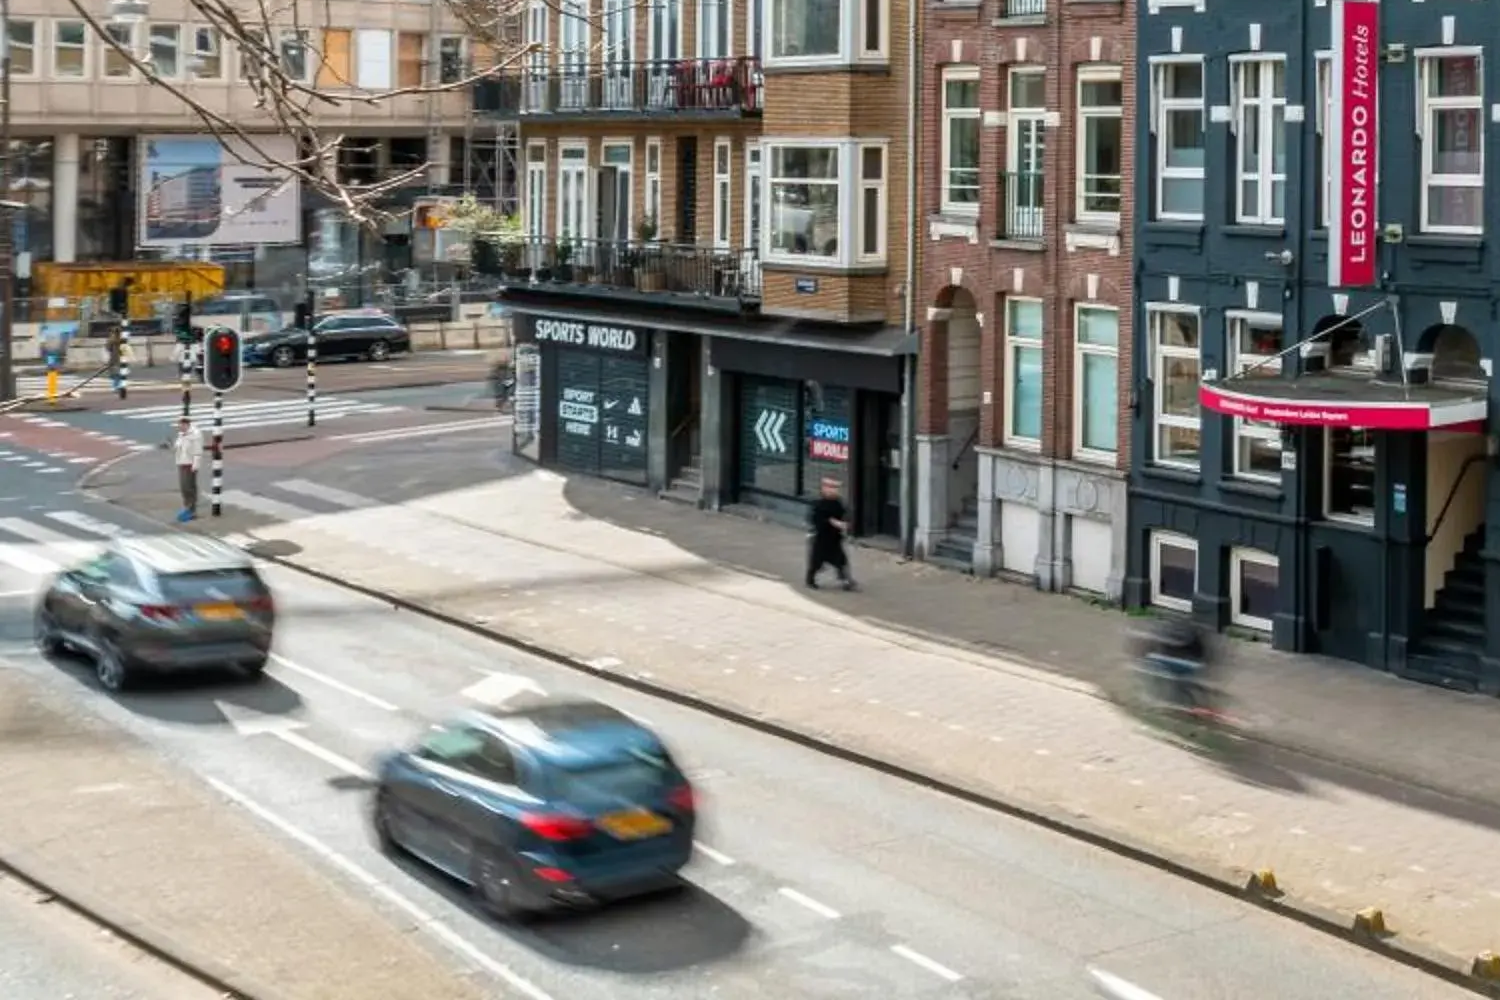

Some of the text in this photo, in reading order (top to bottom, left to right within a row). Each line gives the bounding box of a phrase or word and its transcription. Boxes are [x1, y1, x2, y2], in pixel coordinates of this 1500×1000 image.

[1351, 24, 1369, 264] LEONARDO Hotels
[535, 319, 636, 350] SPORTS WORLD
[813, 422, 849, 442] SPORTS
